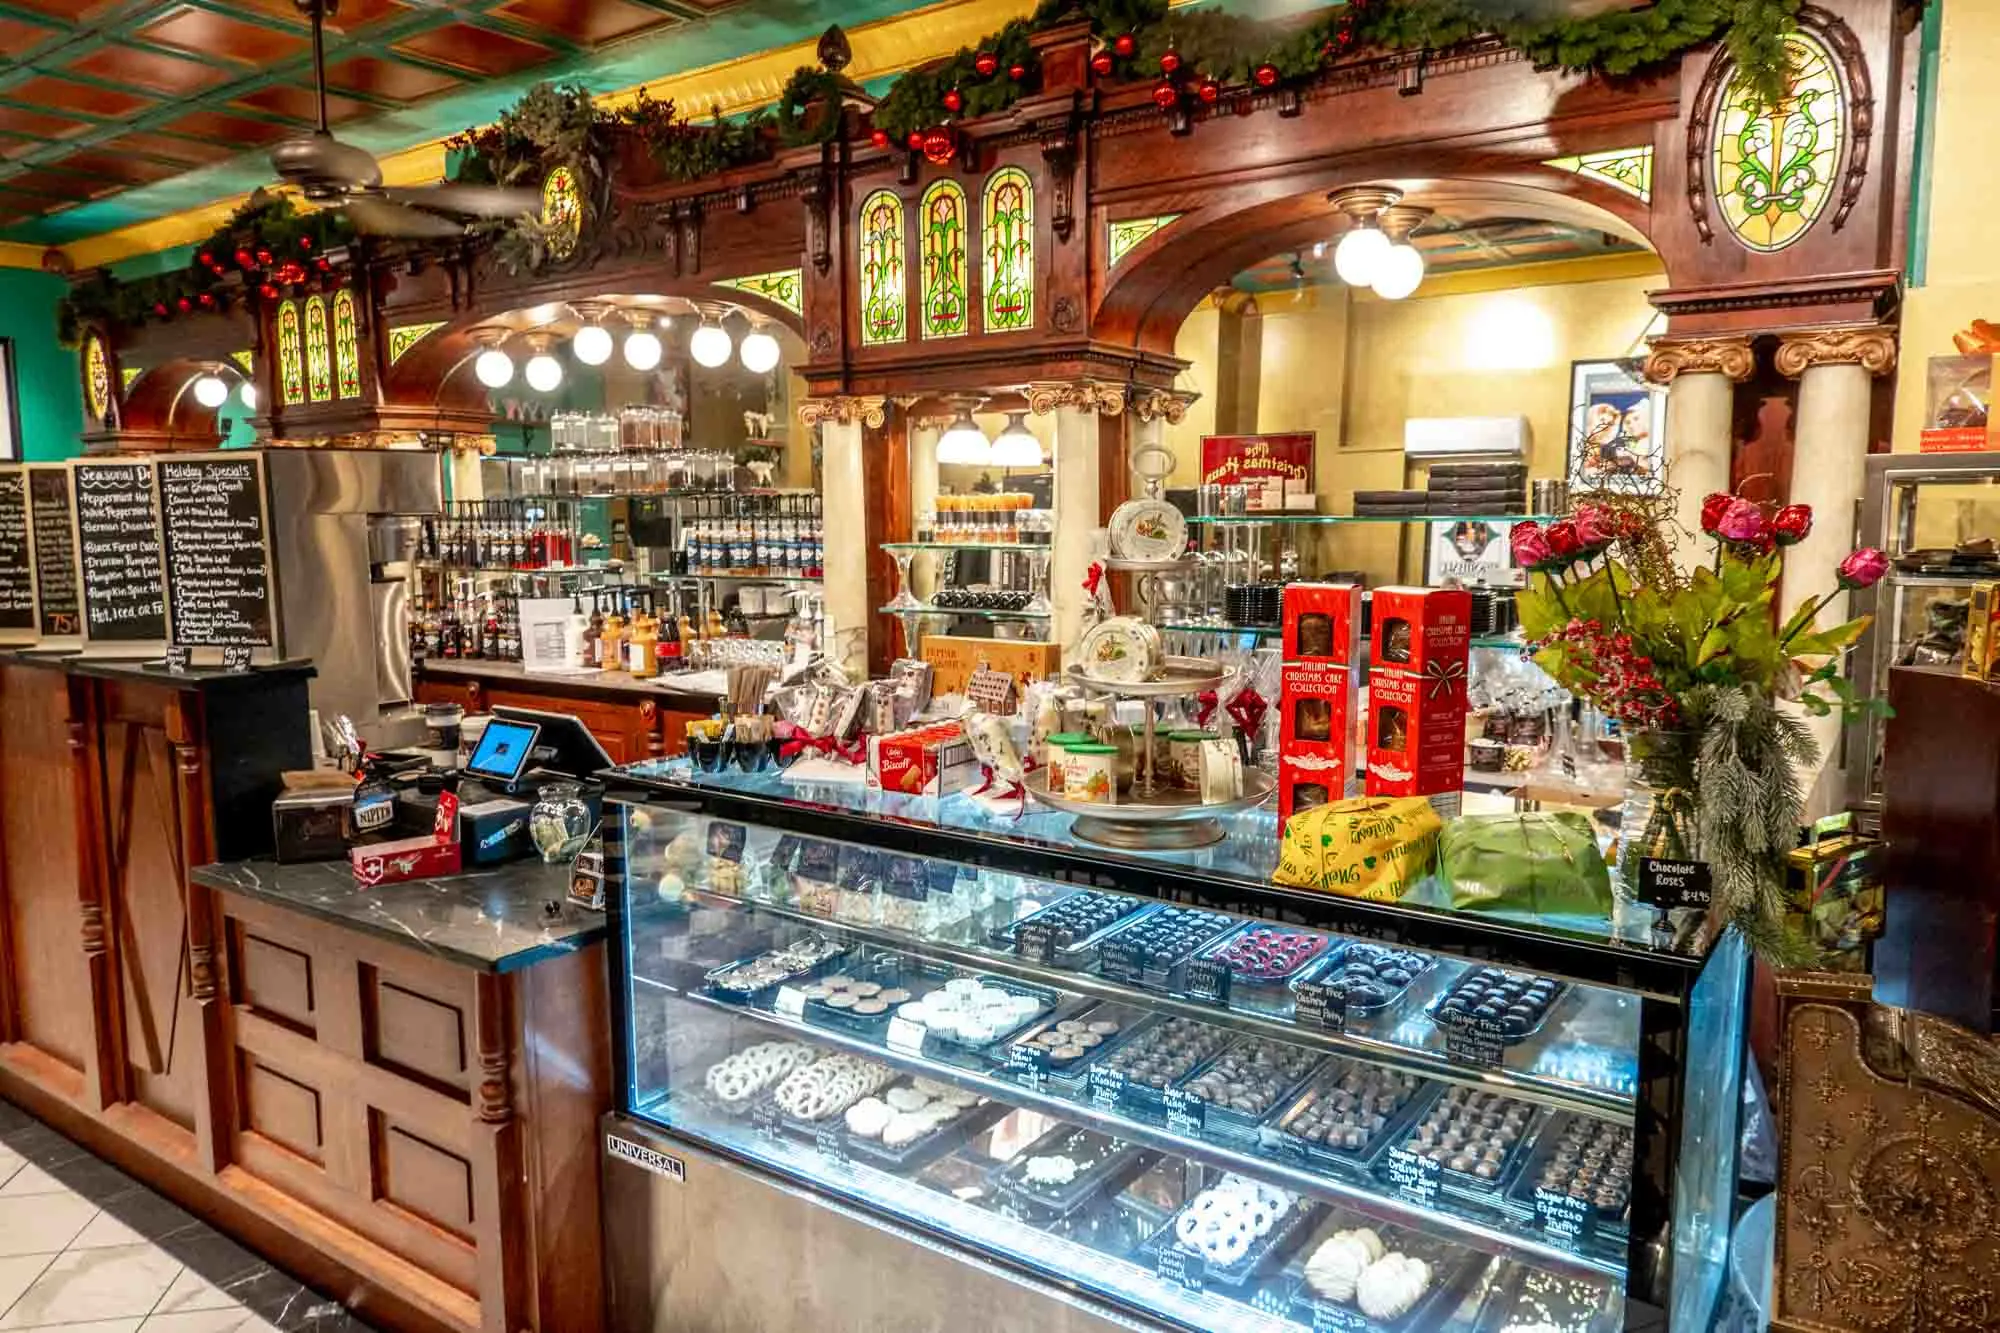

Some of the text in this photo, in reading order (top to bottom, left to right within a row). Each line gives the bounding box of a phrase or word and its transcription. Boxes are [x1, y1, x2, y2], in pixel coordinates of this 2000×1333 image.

[80, 467, 134, 480] Seasonal
[165, 464, 250, 482] Holiday Specials
[124, 554, 158, 568] Pumpkin
[89, 586, 127, 602] Pumpkin
[1300, 661, 1327, 673] ITALIAN
[1285, 671, 1343, 685] CHRISTMAS CAKE
[1371, 676, 1417, 693] CHRISTMAS CAKE
[1289, 682, 1338, 694] COLLECTION
[1374, 688, 1413, 704] COLLECTION
[881, 757, 912, 772] Biscoff
[1649, 860, 1696, 875] Chocolate
[1655, 873, 1686, 888] Roses
[1298, 980, 1345, 1000] Sugar Free
[1450, 1010, 1477, 1030] Sugar
[1479, 1019, 1502, 1033] Free
[1163, 1083, 1185, 1101] Sugar
[611, 1137, 679, 1175] UNIVERSAL
[1388, 1145, 1441, 1171] Sugar Free
[1388, 1158, 1426, 1181] Orange
[1535, 1186, 1588, 1212] Sugar Free
[1536, 1200, 1584, 1223] Espresso
[1544, 1216, 1583, 1235] Truffle
